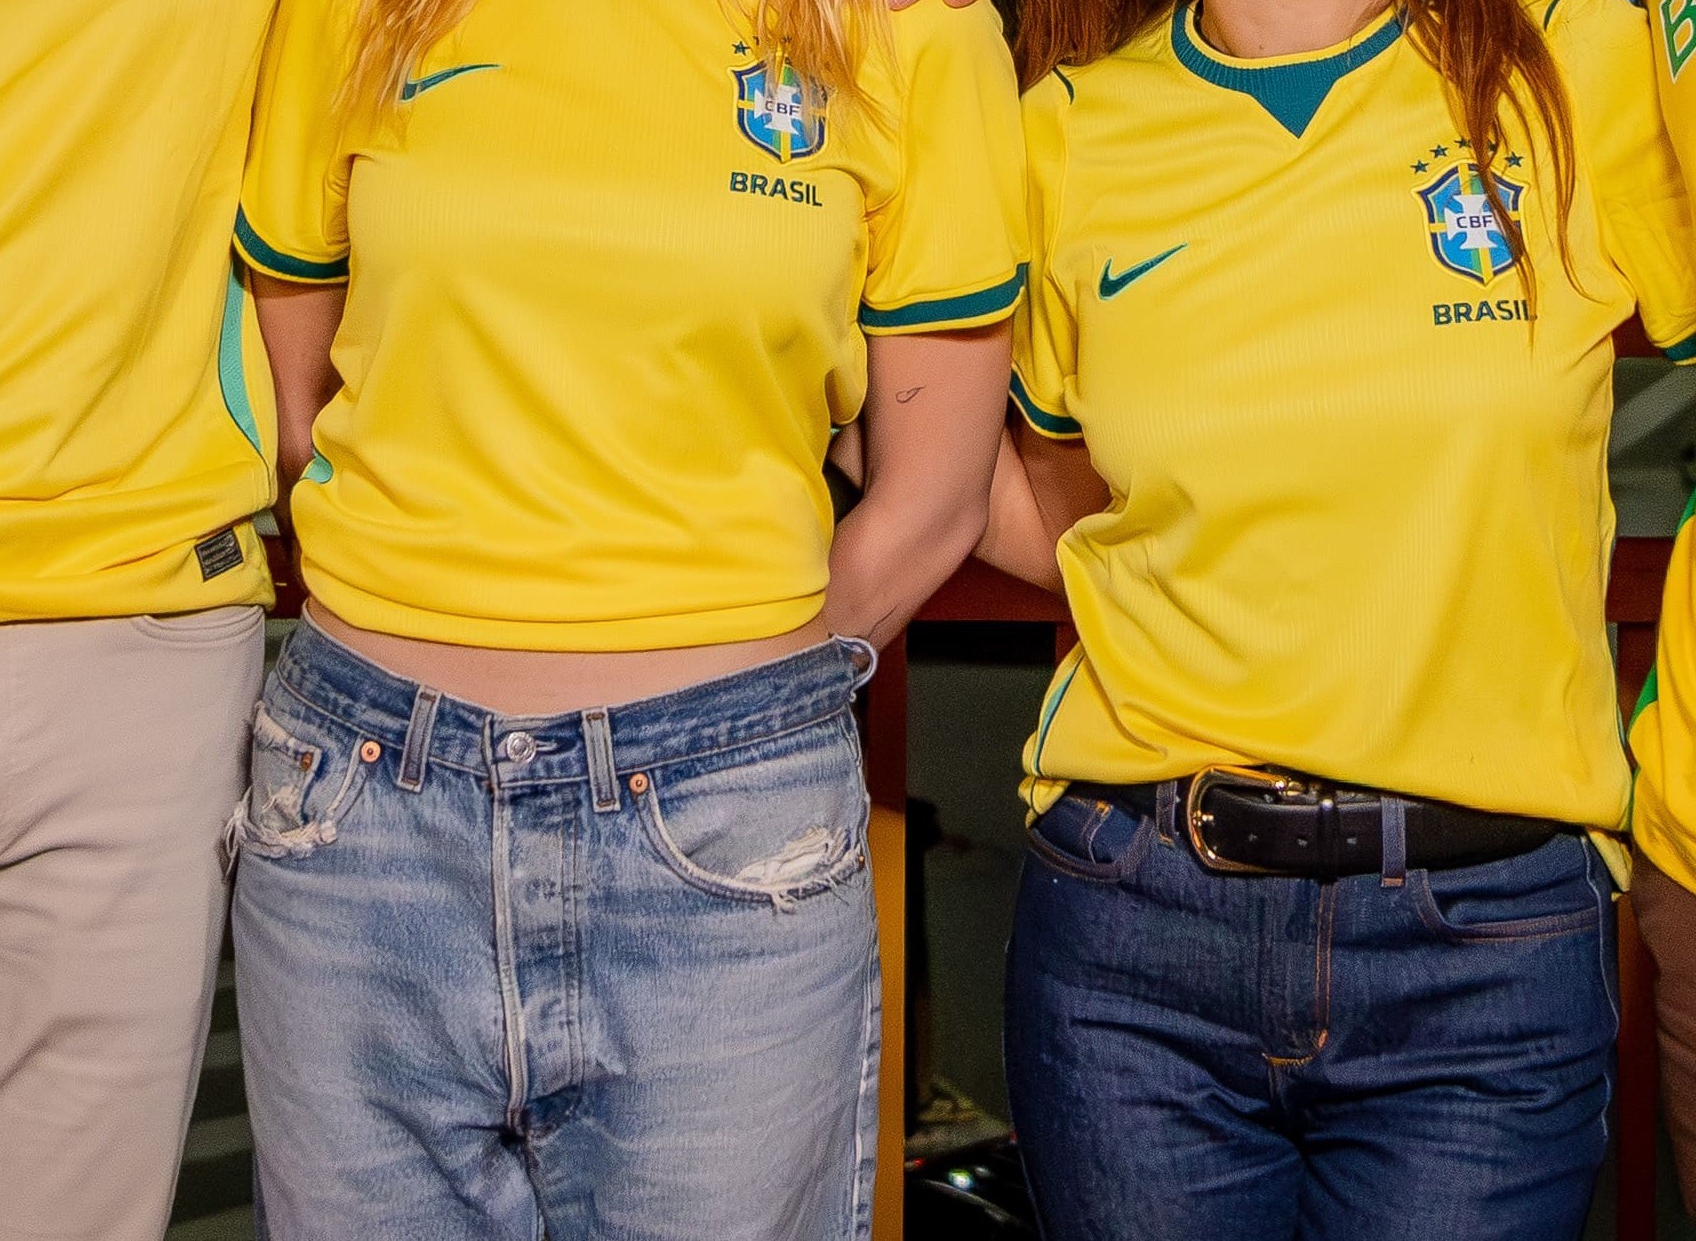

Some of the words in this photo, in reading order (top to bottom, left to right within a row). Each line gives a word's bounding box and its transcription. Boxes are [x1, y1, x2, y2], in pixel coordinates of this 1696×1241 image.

[765, 100, 801, 116] CBF
[730, 171, 823, 207] BRASIL
[1456, 215, 1493, 229] CBF
